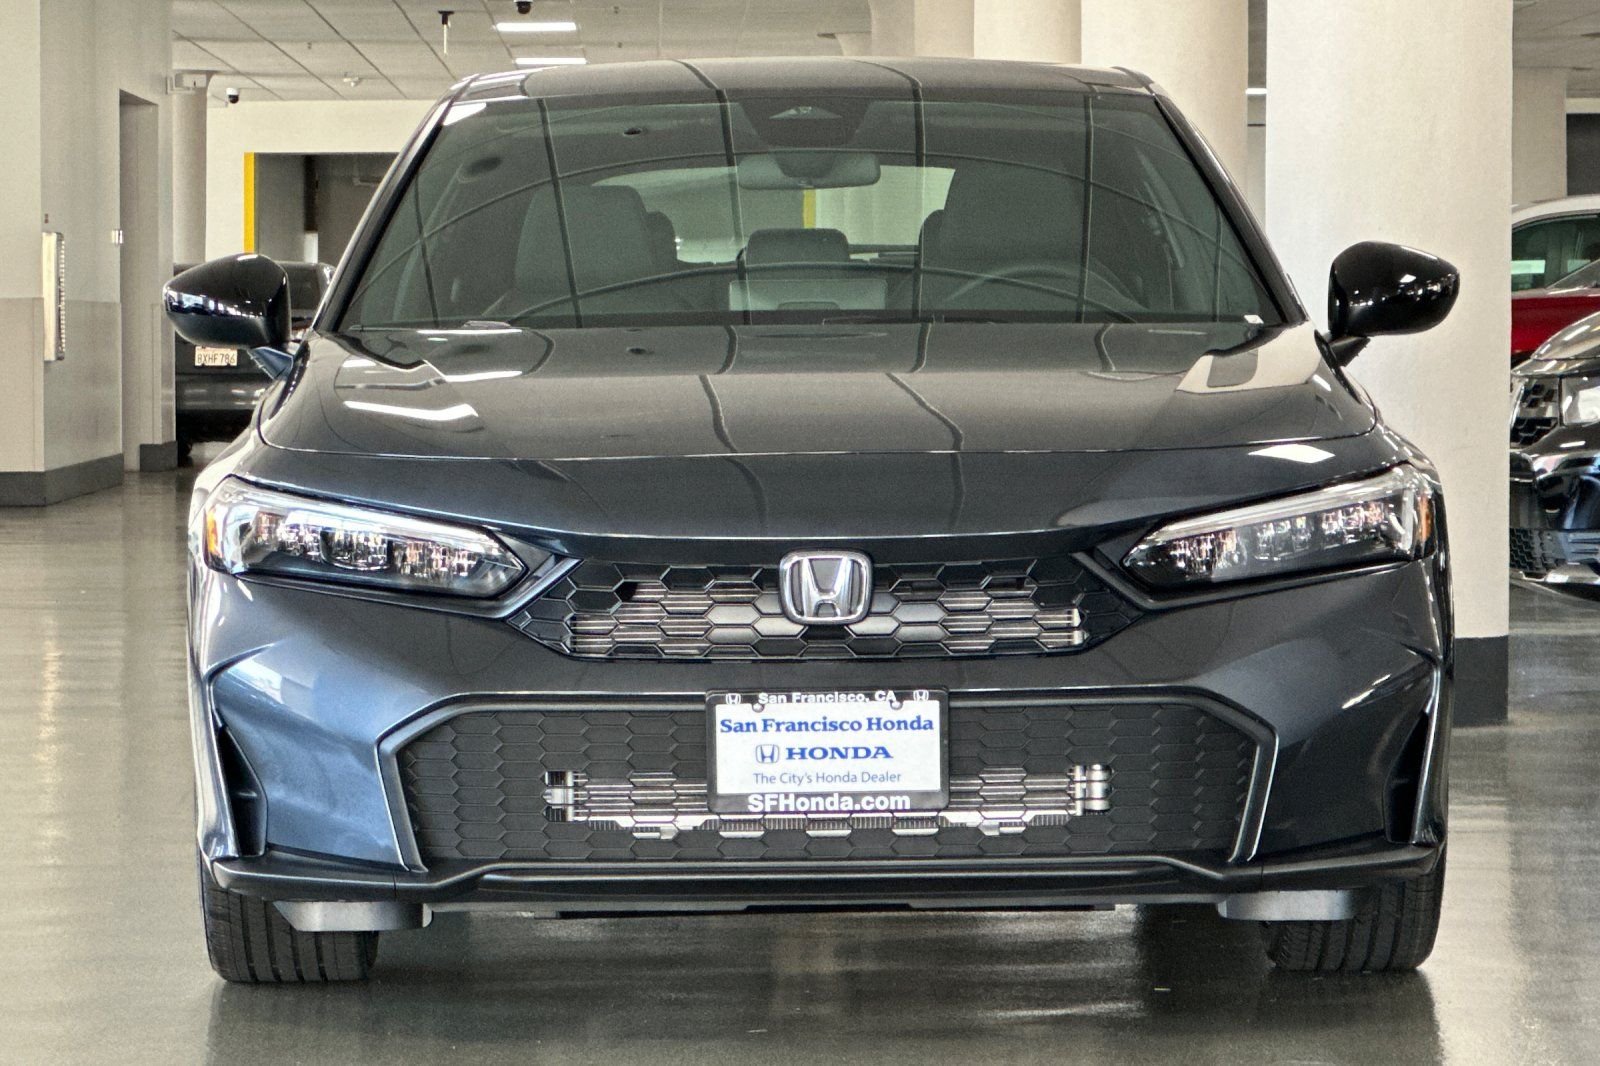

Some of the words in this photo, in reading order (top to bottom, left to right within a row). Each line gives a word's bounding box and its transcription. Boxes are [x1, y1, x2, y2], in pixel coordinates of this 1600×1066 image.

[758, 692, 787, 704] San
[792, 691, 870, 704] Francisco,
[874, 690, 897, 702] CA
[720, 718, 758, 733] San
[761, 715, 863, 733] Francisco
[866, 714, 934, 731] Honda
[785, 746, 894, 760] HONDA
[753, 772, 776, 784] The
[779, 771, 813, 787] City's
[816, 770, 857, 783] Honda
[861, 770, 901, 783] Dealer
[747, 792, 911, 813] SFHonda.com
